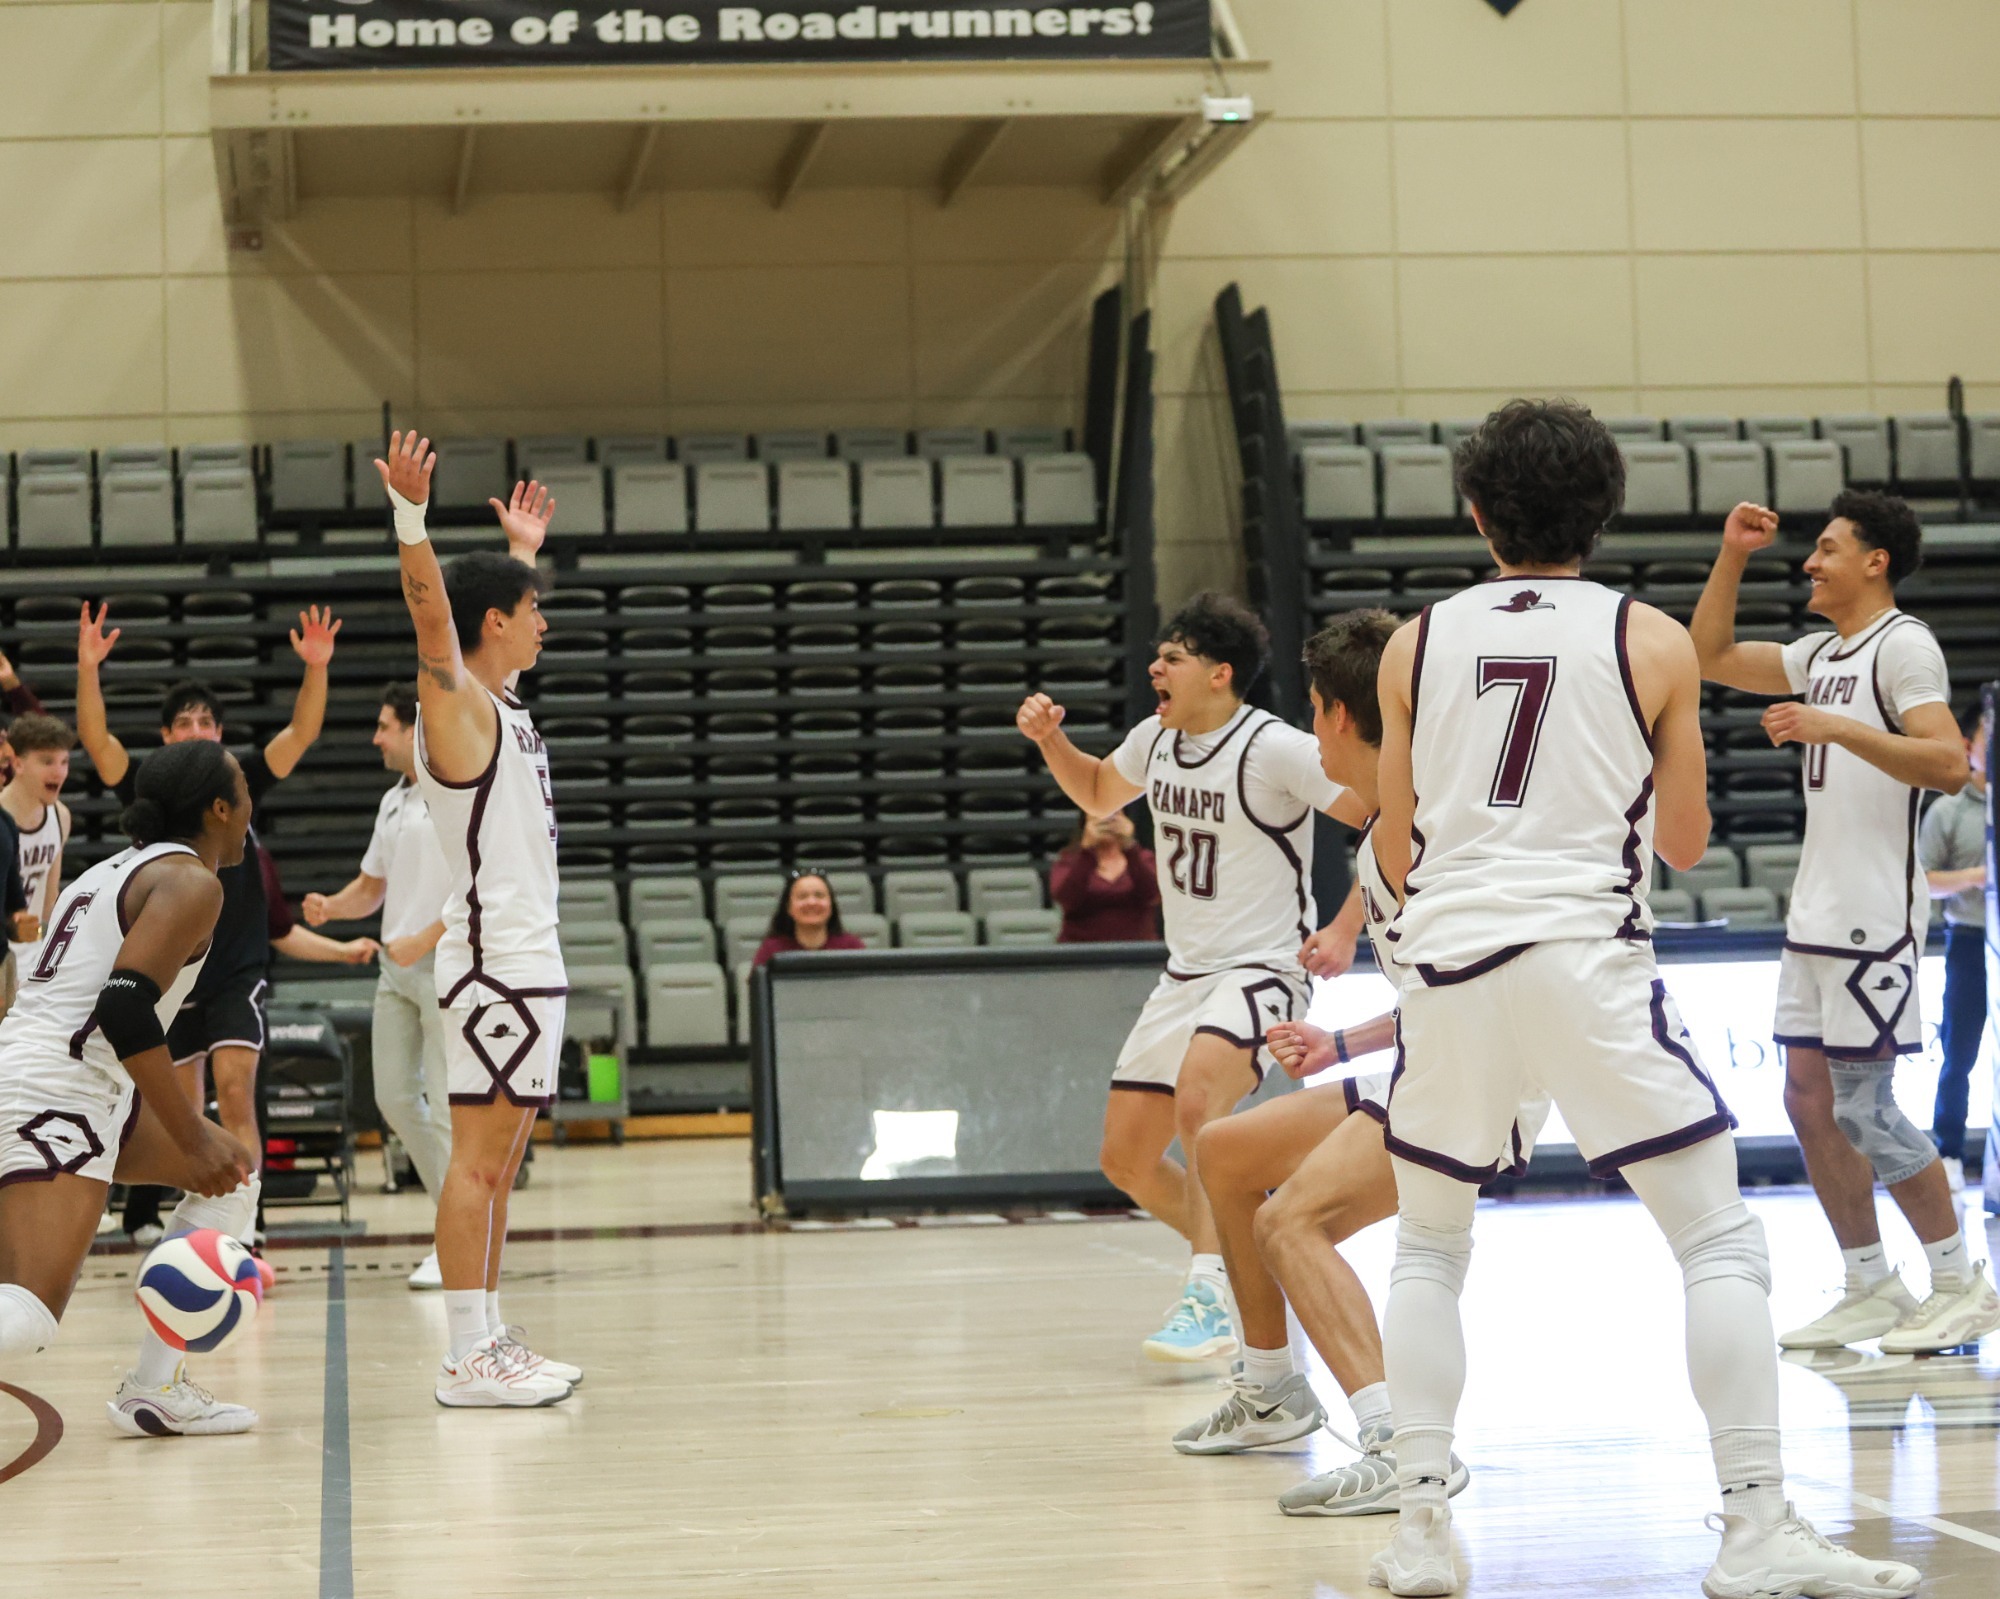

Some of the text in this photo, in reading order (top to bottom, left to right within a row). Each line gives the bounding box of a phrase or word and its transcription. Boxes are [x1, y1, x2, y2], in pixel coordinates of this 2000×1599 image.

[309, 1, 1155, 48] Home of the Roadrunners!
[1476, 655, 1557, 809] 7
[1152, 778, 1225, 824] RAMAPO
[1160, 821, 1219, 901] 20
[27, 887, 101, 983] 6
